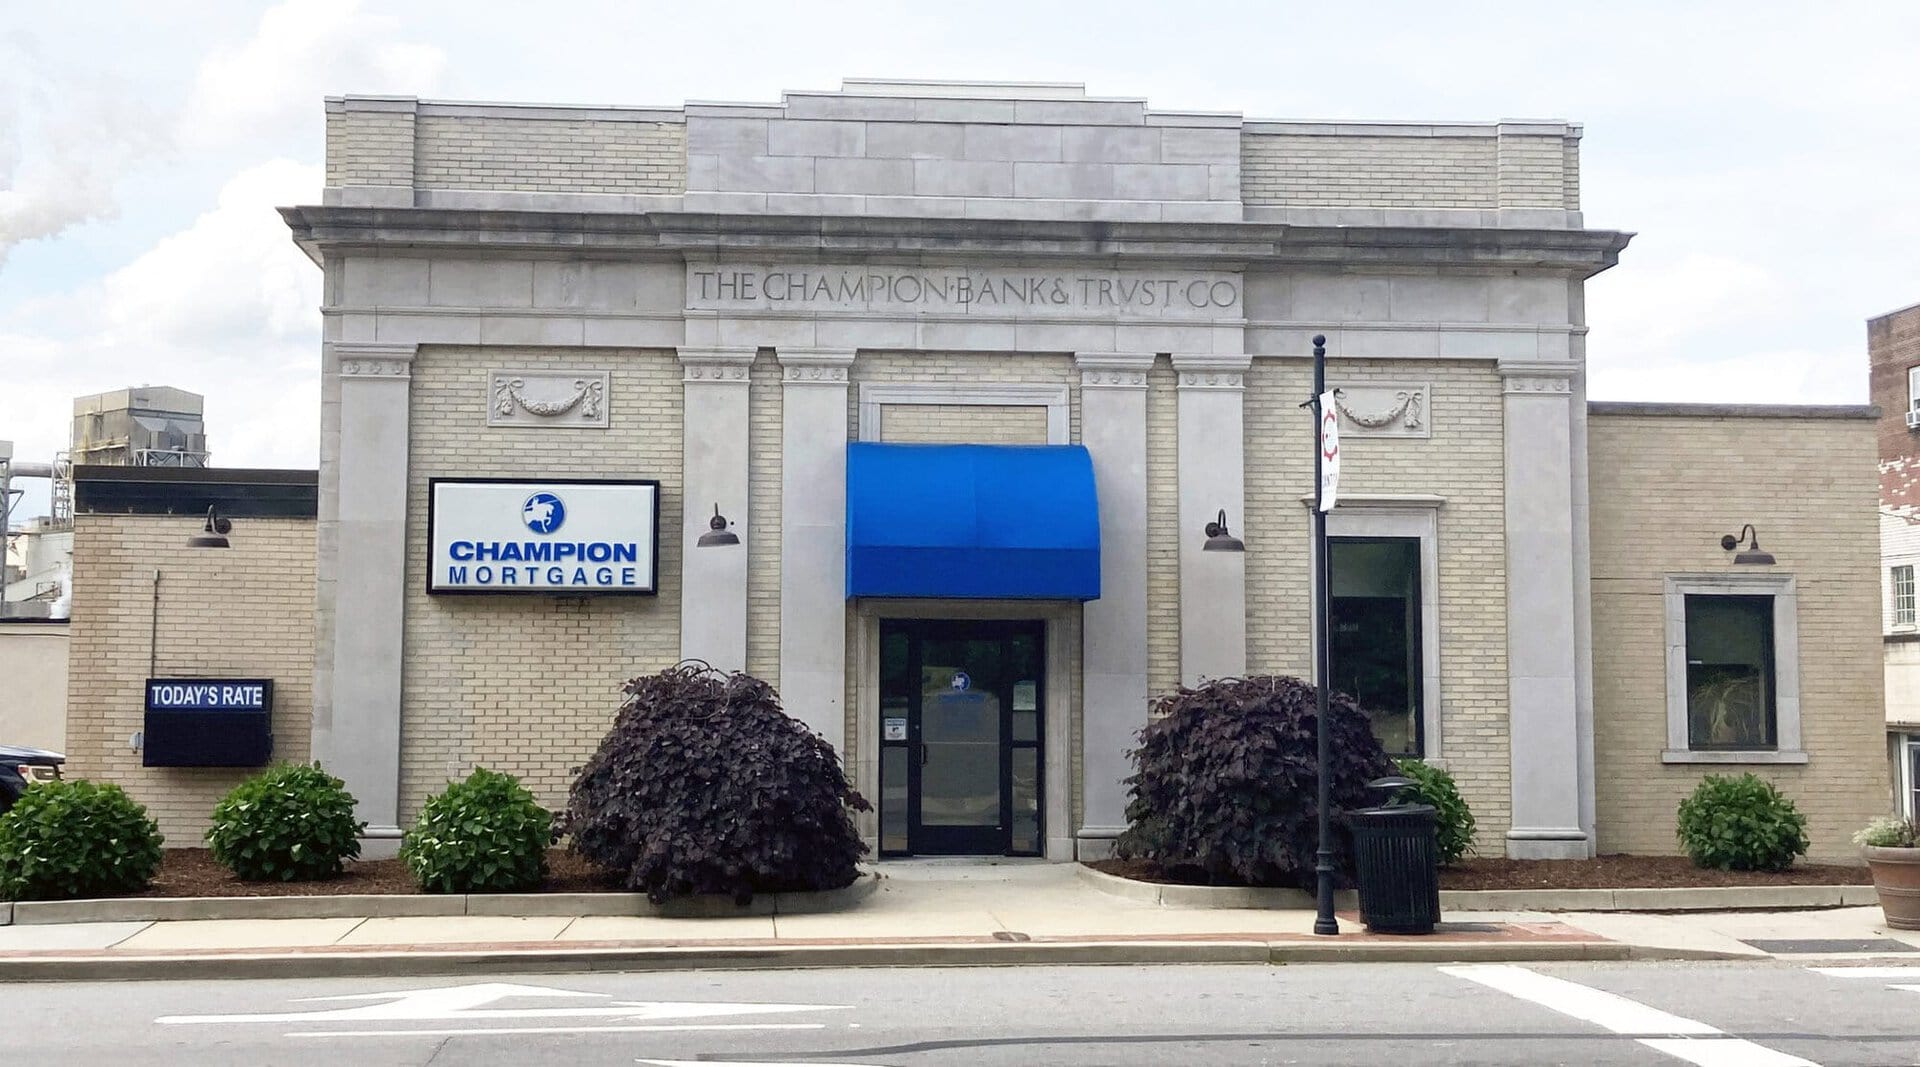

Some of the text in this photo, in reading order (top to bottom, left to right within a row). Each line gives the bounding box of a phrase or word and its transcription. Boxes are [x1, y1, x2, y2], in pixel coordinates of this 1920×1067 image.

[694, 271, 757, 300] THE
[762, 272, 949, 303] CHAMPION
[955, 276, 1047, 305] BANK
[1049, 277, 1070, 305] &
[1186, 280, 1237, 308] CO
[449, 540, 637, 563] CHAMPION
[449, 565, 637, 586] MORTGAGE
[152, 686, 263, 706] TODAY'S RATE
